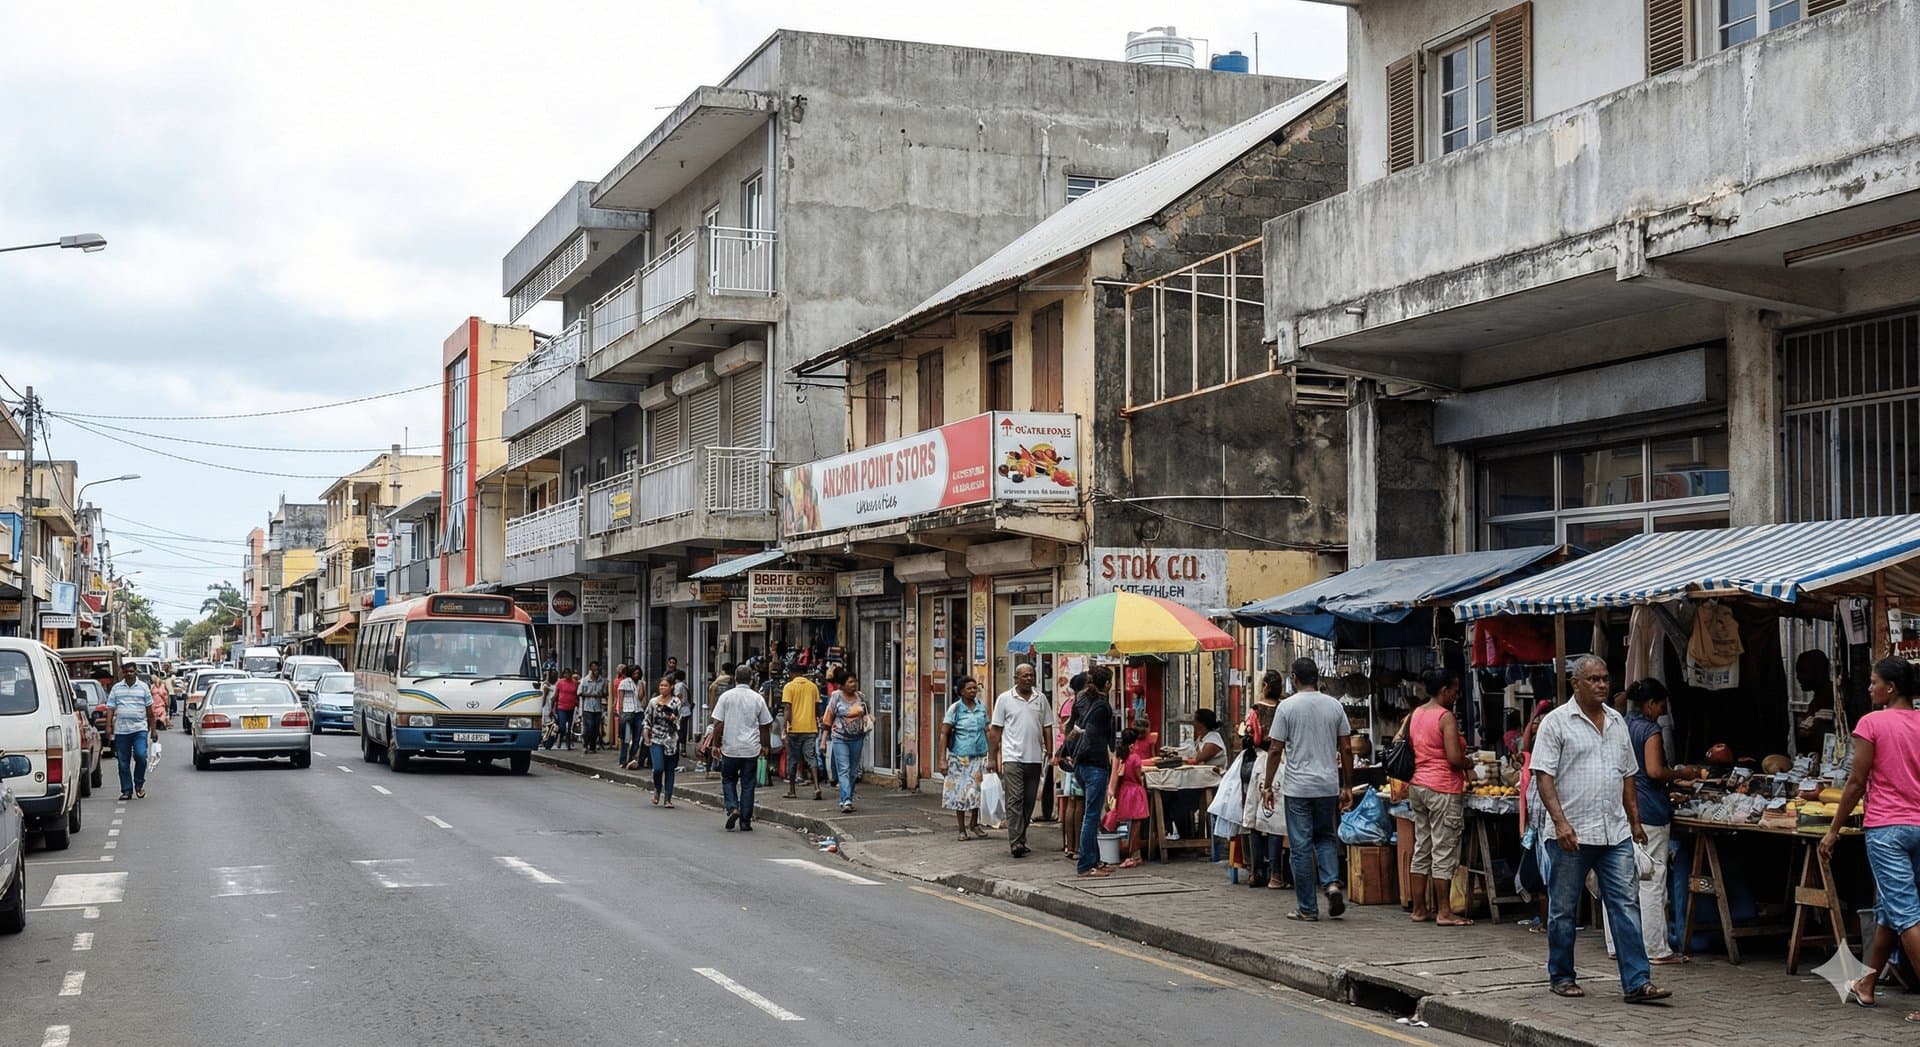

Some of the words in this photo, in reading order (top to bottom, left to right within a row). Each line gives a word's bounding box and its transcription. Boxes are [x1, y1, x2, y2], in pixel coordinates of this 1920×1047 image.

[861, 453, 894, 491] POINT
[896, 440, 936, 483] STORS
[1102, 554, 1160, 580] STOK
